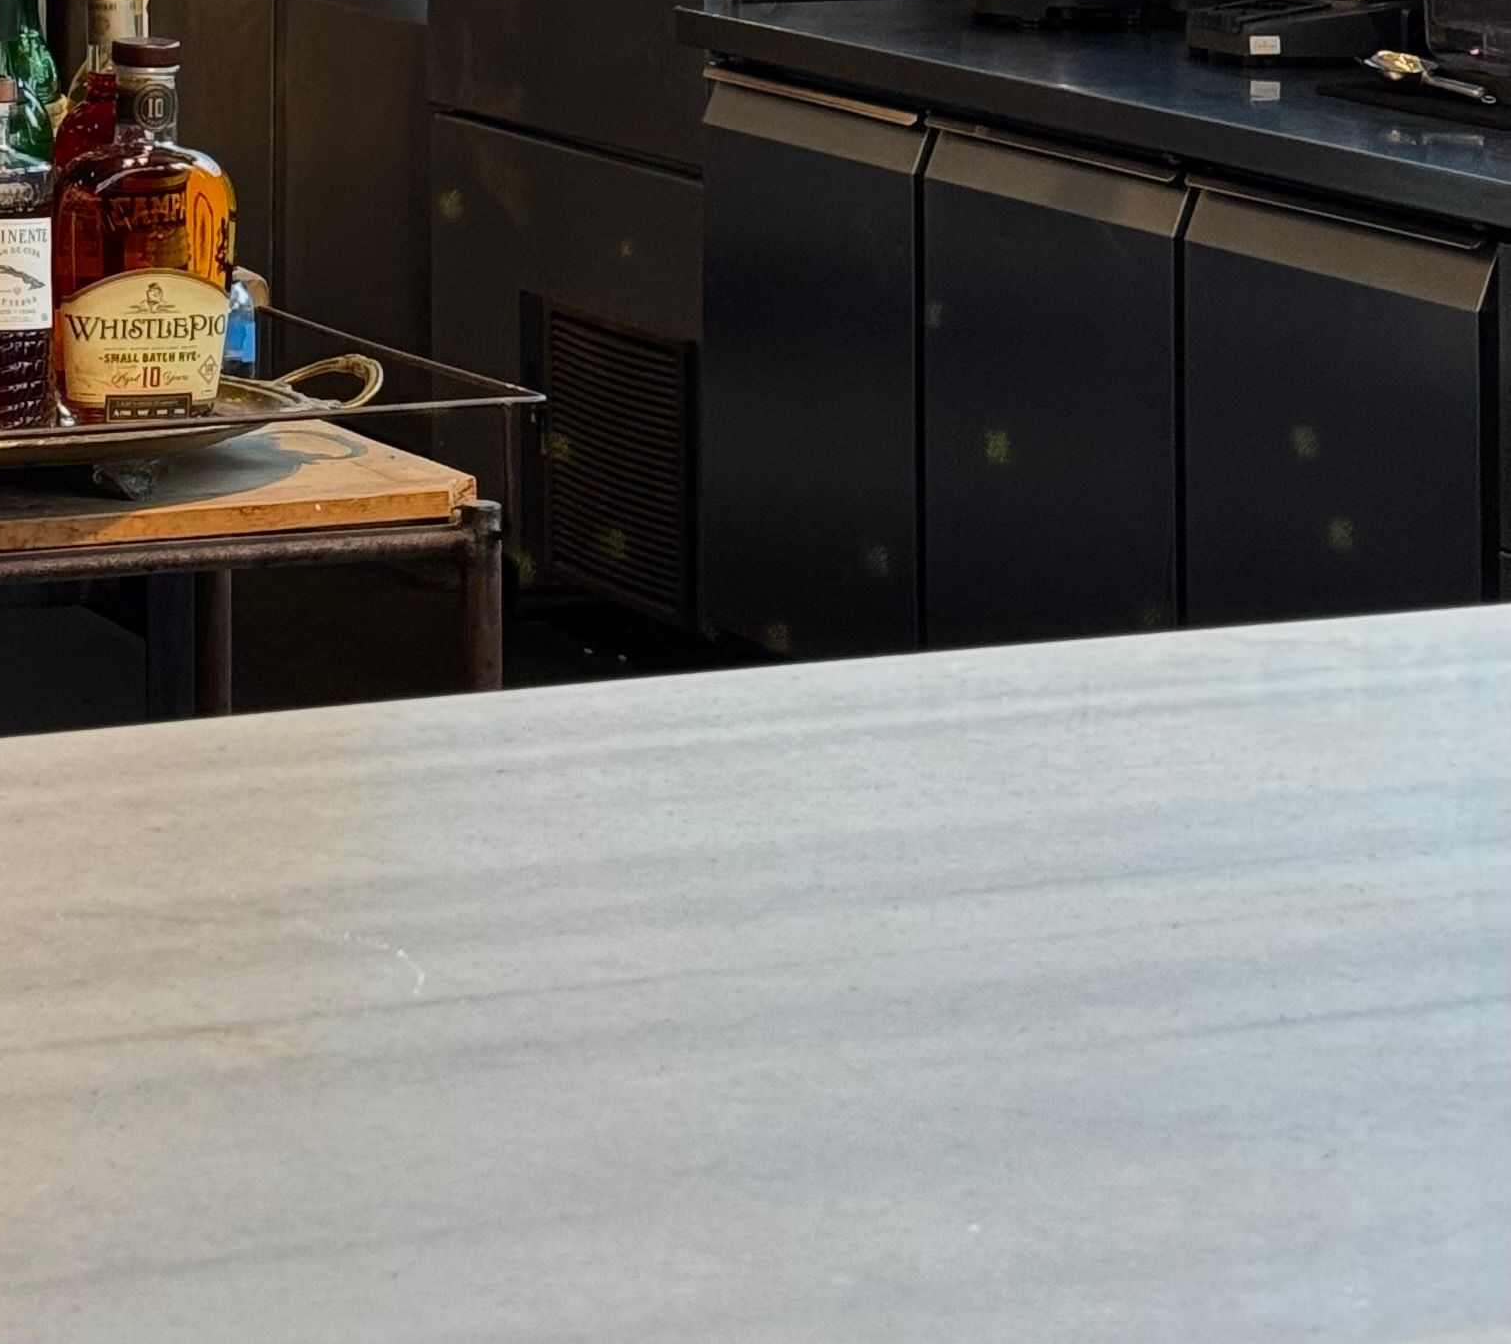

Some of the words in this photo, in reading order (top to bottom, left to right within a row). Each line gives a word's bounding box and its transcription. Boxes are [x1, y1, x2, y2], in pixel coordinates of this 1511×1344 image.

[147, 97, 164, 118] 10
[104, 353, 139, 364] SMALL
[142, 352, 176, 363] BATCH
[142, 366, 161, 388] 10
